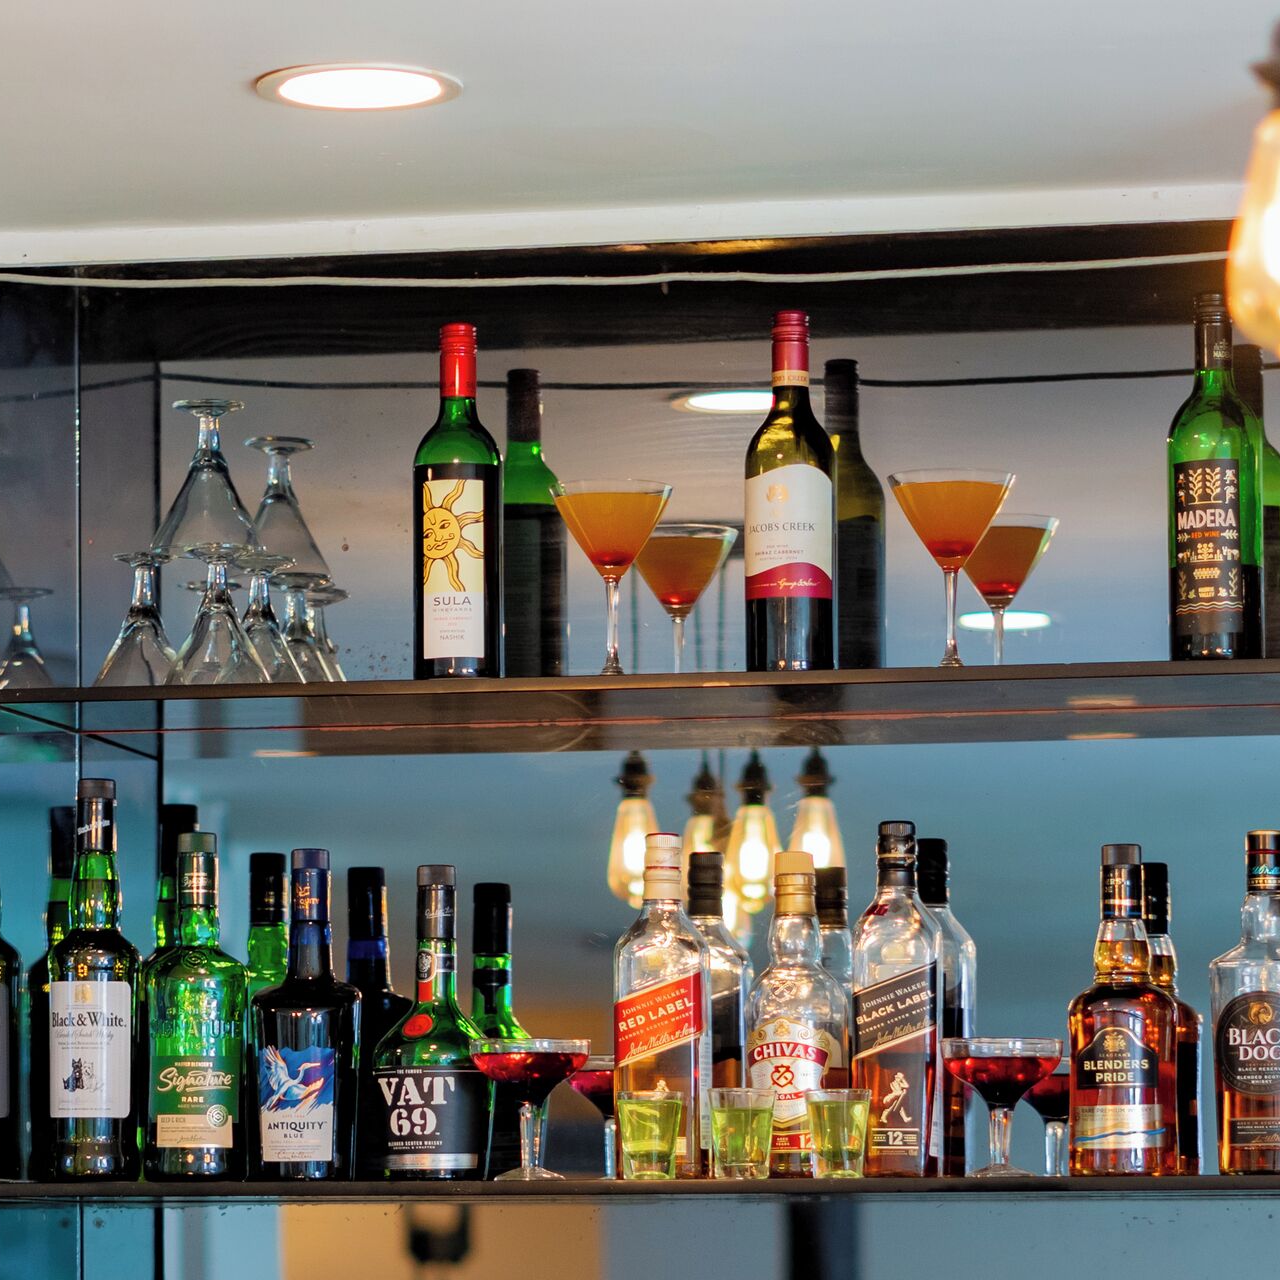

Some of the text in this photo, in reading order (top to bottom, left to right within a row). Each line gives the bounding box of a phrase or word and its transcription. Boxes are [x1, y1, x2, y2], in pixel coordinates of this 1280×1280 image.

[1177, 508, 1237, 530] MADERA
[749, 522, 816, 534] JACOB'S CREEK
[433, 596, 472, 606] SULA
[622, 1000, 654, 1018] JOHNNIE
[856, 990, 935, 1025] BLACK LABEL
[862, 993, 895, 1011] JOHNNIE
[52, 1011, 76, 1028] Black
[76, 1013, 87, 1026] &
[618, 997, 694, 1032] RED LABEL
[753, 1043, 817, 1060] CHIVAS
[1084, 1060, 1149, 1070] BLENDERS
[157, 1067, 232, 1092] Signature
[1095, 1072, 1135, 1082] PRIDE
[377, 1076, 455, 1106] VAT
[267, 1121, 324, 1132] ANTIQUITY
[390, 1107, 437, 1136] 69
[799, 1134, 812, 1149] 12
[887, 1131, 903, 1145] 12
